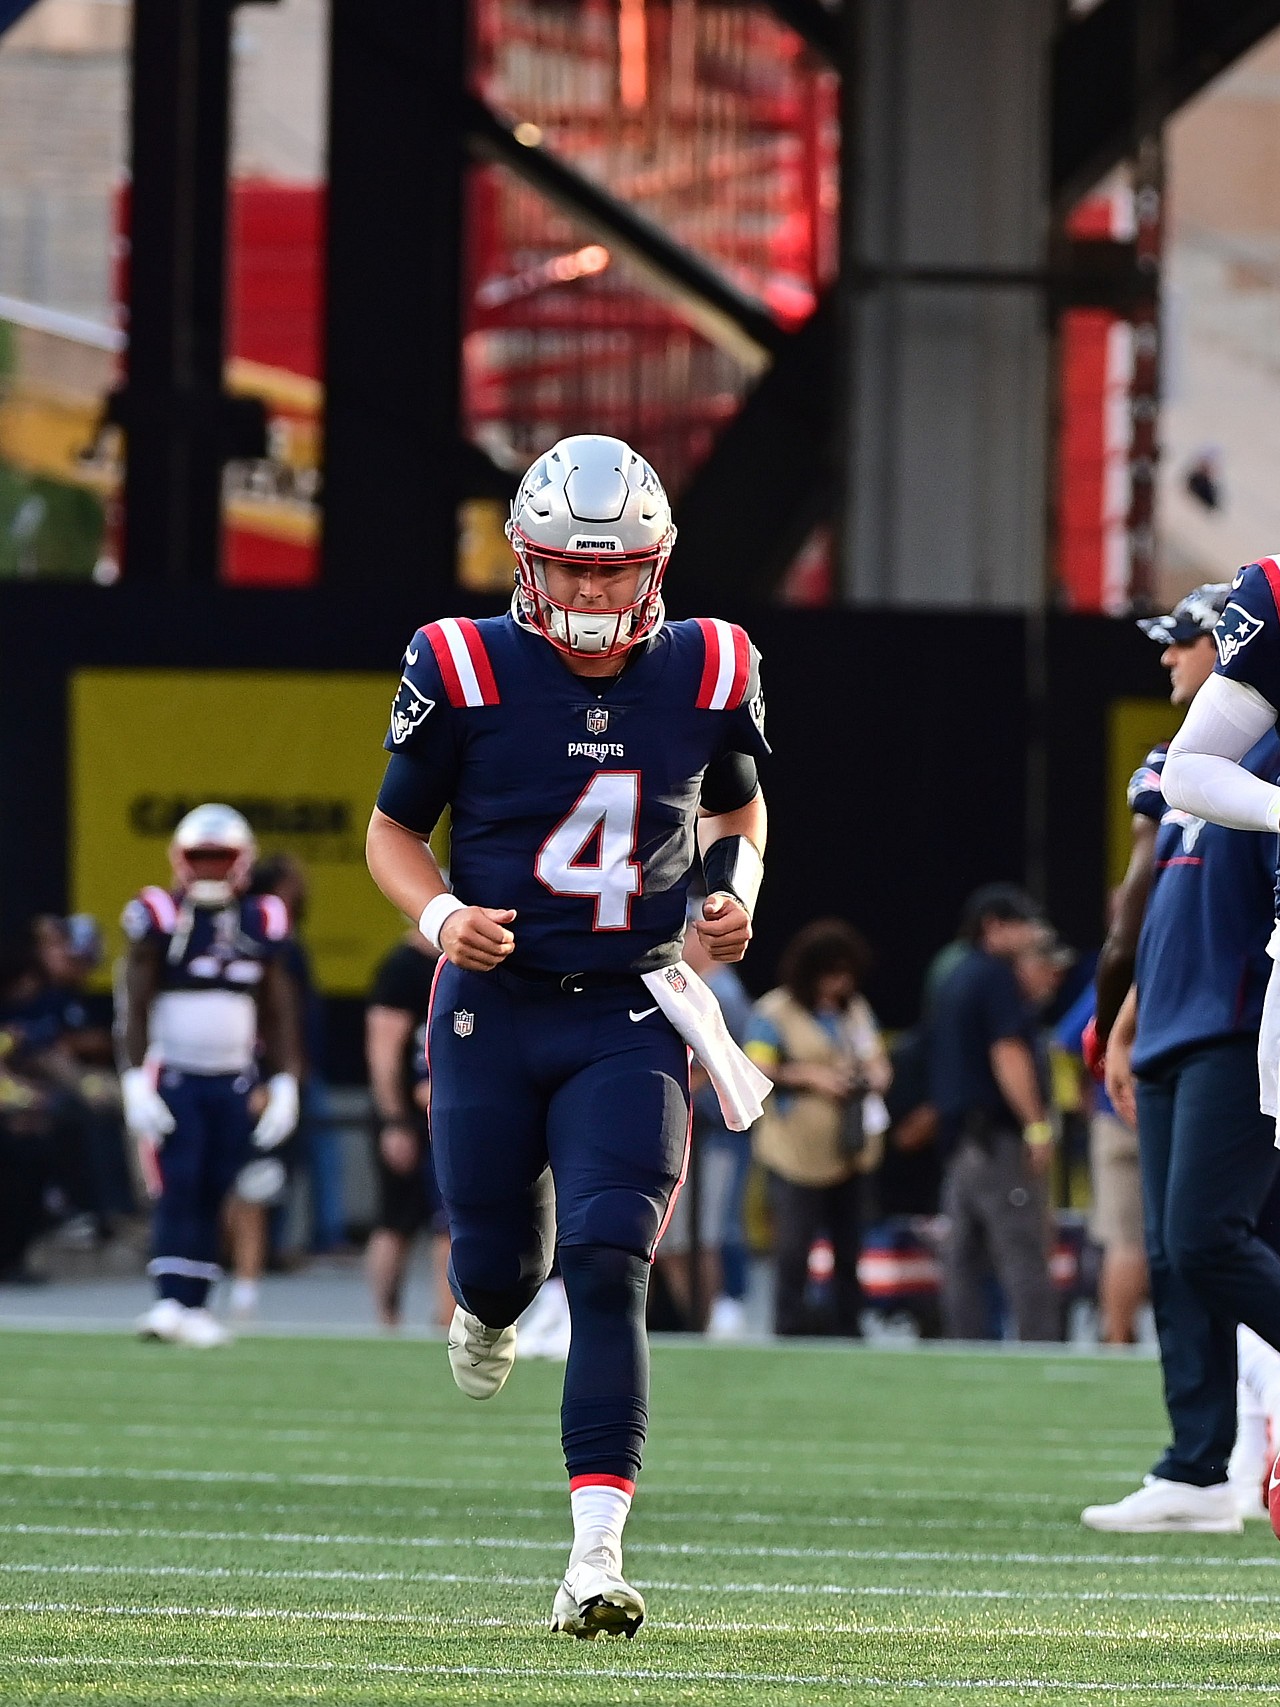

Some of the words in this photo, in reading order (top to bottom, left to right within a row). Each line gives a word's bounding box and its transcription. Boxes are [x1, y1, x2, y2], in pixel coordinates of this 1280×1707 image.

[576, 540, 616, 551] PATRIOTS
[568, 742, 624, 757] PATRIOTS
[534, 770, 643, 932] 4
